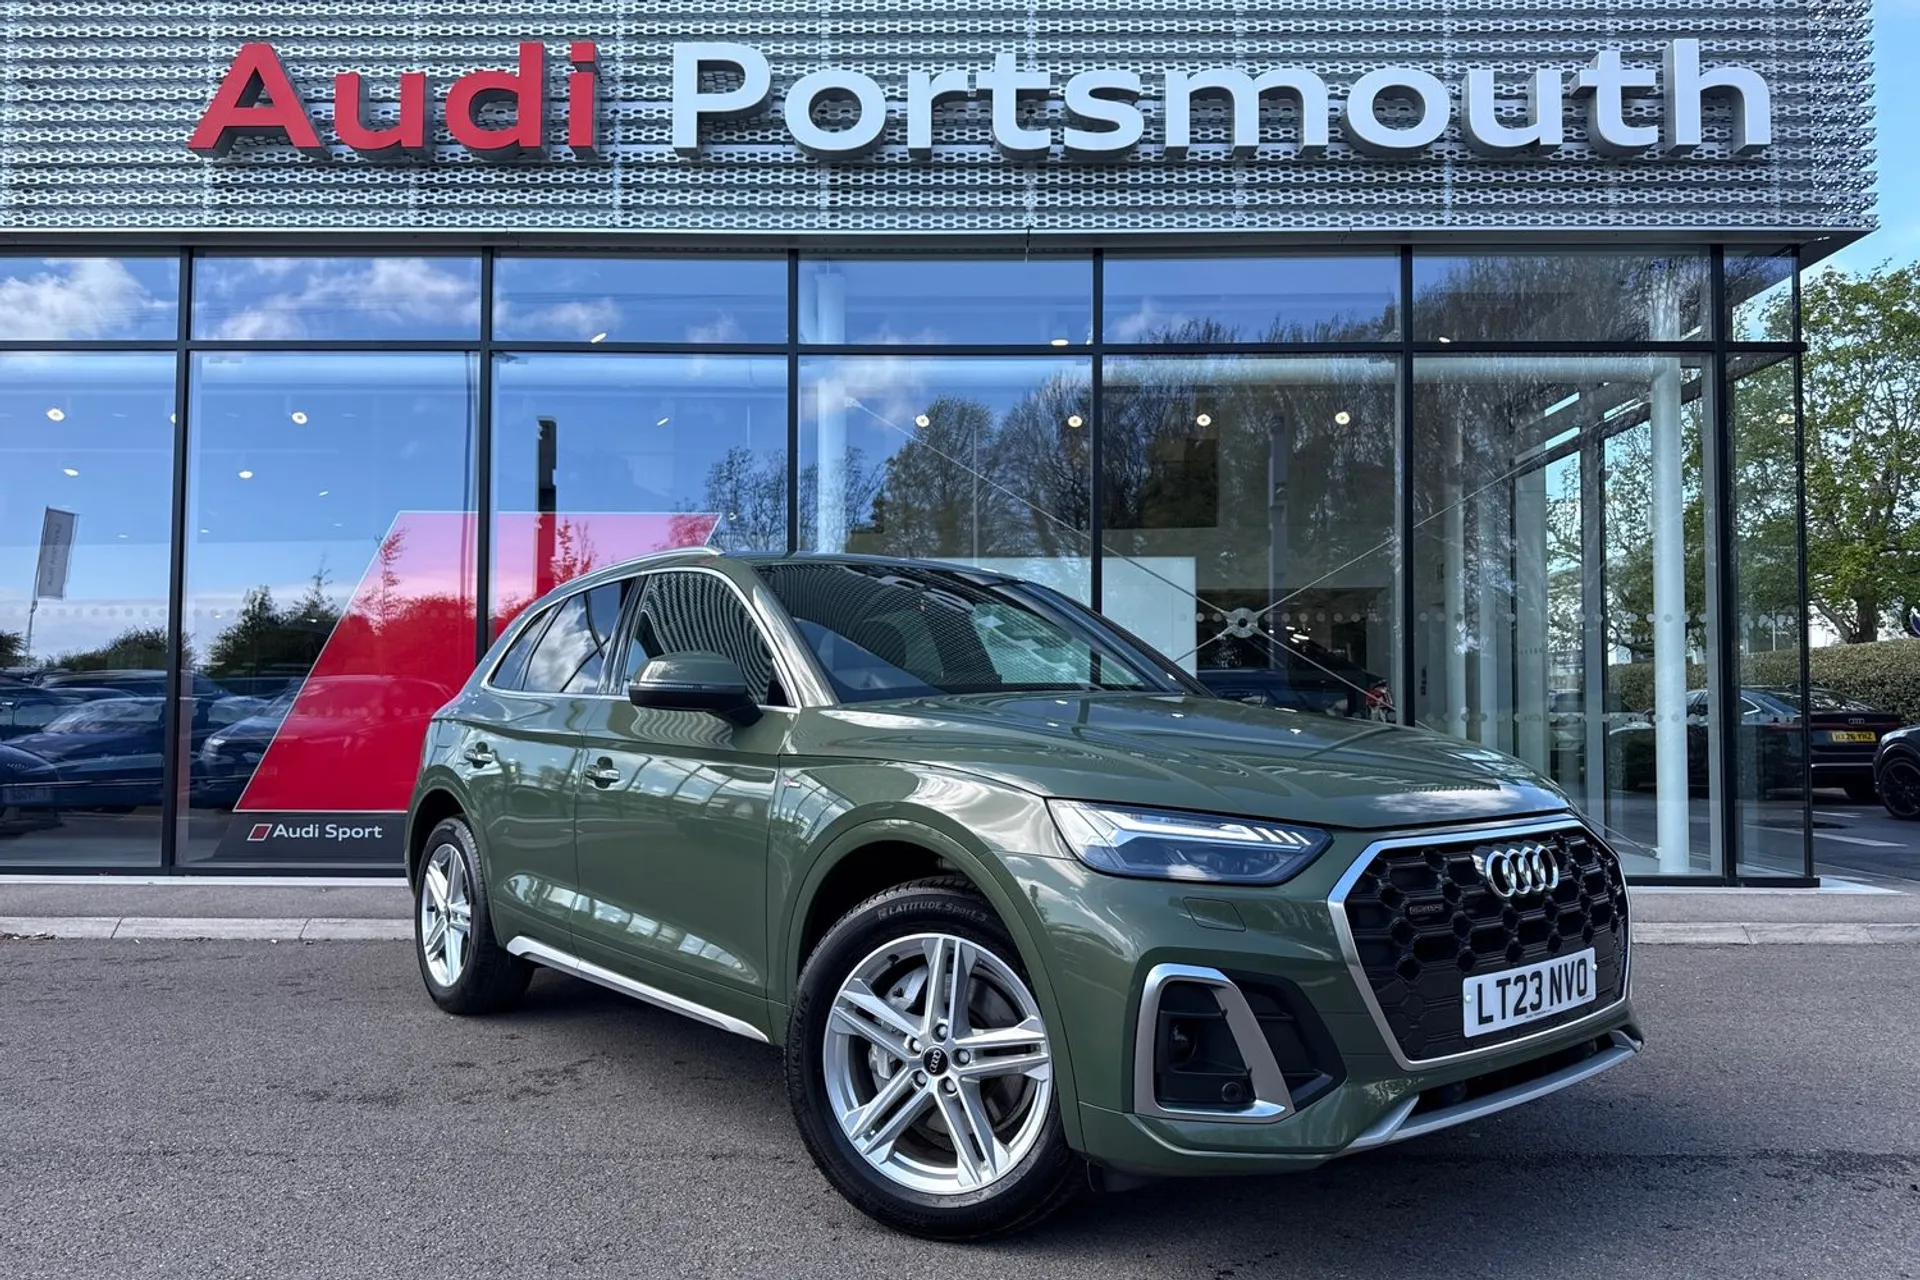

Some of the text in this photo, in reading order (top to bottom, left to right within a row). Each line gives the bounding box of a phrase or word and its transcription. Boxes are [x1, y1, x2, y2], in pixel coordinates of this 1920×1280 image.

[188, 38, 1773, 152] Audi Portsmouth
[272, 824, 383, 841] Audi Sport
[889, 901, 943, 915] LATITUDE
[945, 902, 977, 918] Sport
[1477, 958, 1588, 1026] LT23 NVO
